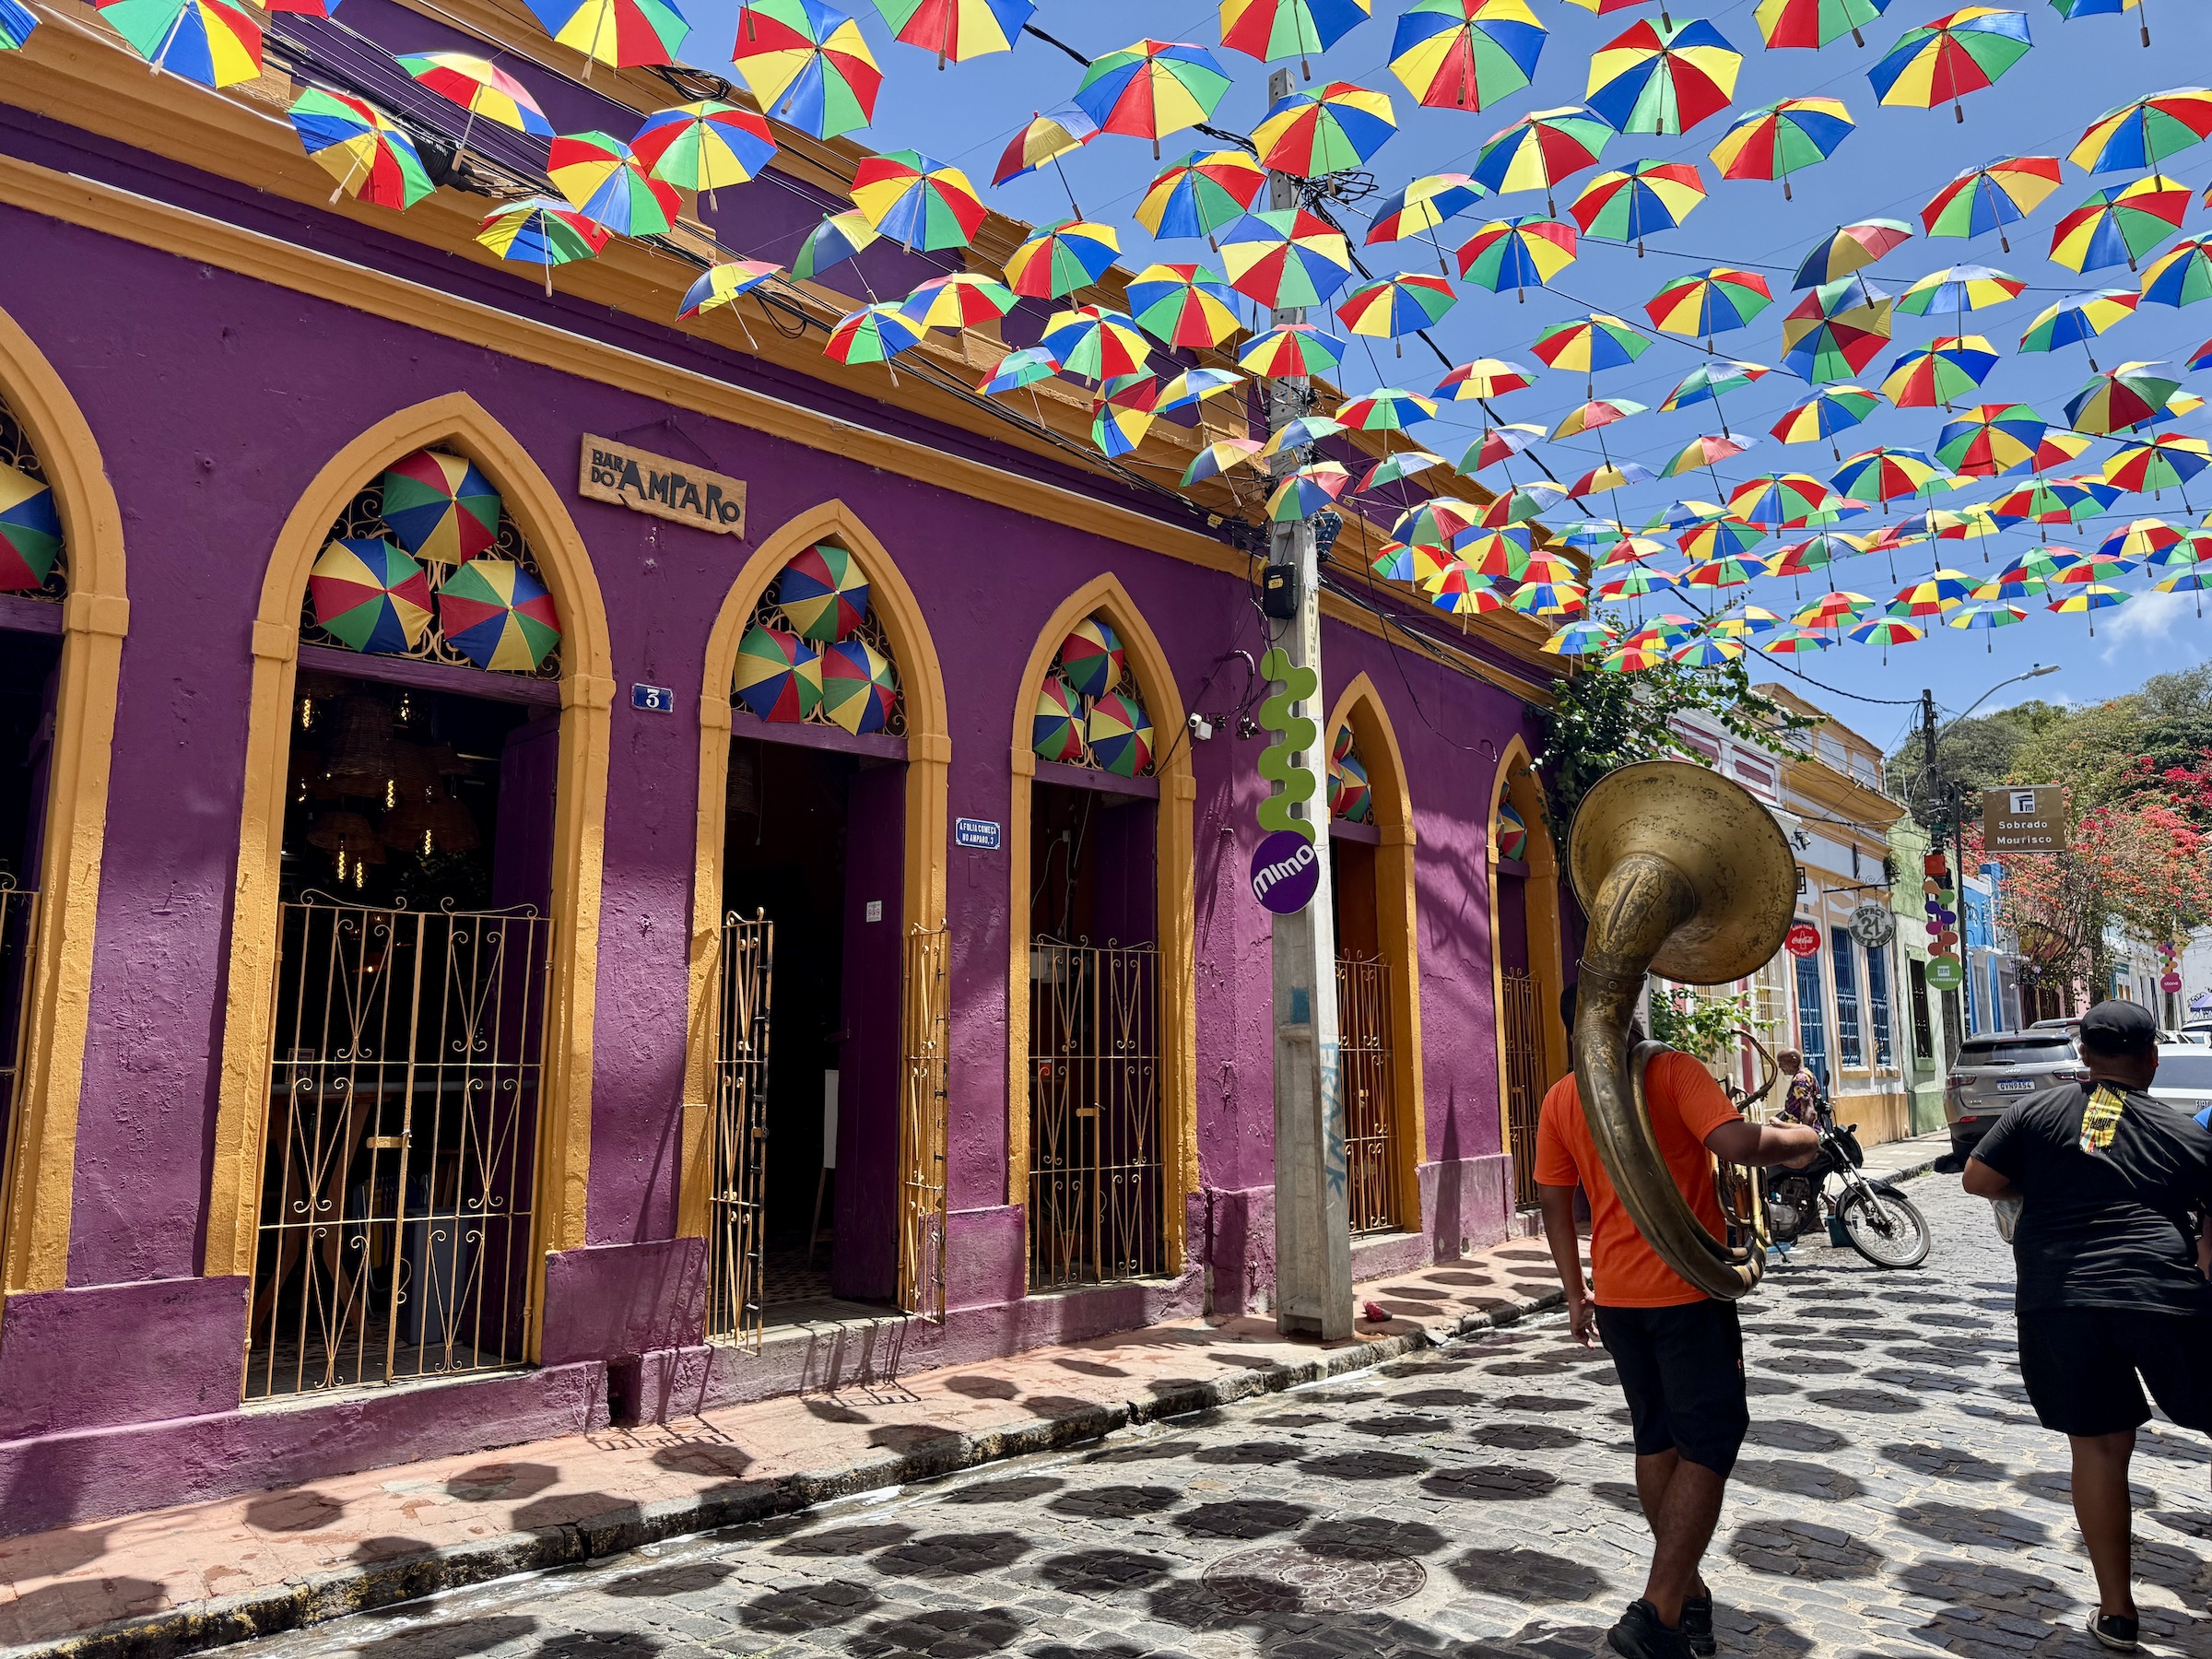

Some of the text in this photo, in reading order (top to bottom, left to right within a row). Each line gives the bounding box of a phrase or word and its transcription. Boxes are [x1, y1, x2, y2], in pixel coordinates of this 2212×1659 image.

[592, 448, 624, 473] BAR
[591, 466, 615, 487] DO
[616, 459, 740, 524] AMPARO
[646, 688, 660, 708] 3
[963, 823, 978, 832] FOLIA
[978, 825, 996, 835] COMEÇA
[1998, 820, 2048, 830] Sobrado
[962, 833, 969, 841] NO
[1996, 835, 2053, 844] Mourisco
[1861, 916, 1882, 936] 21
[2194, 1100, 2209, 1109] FIAT
